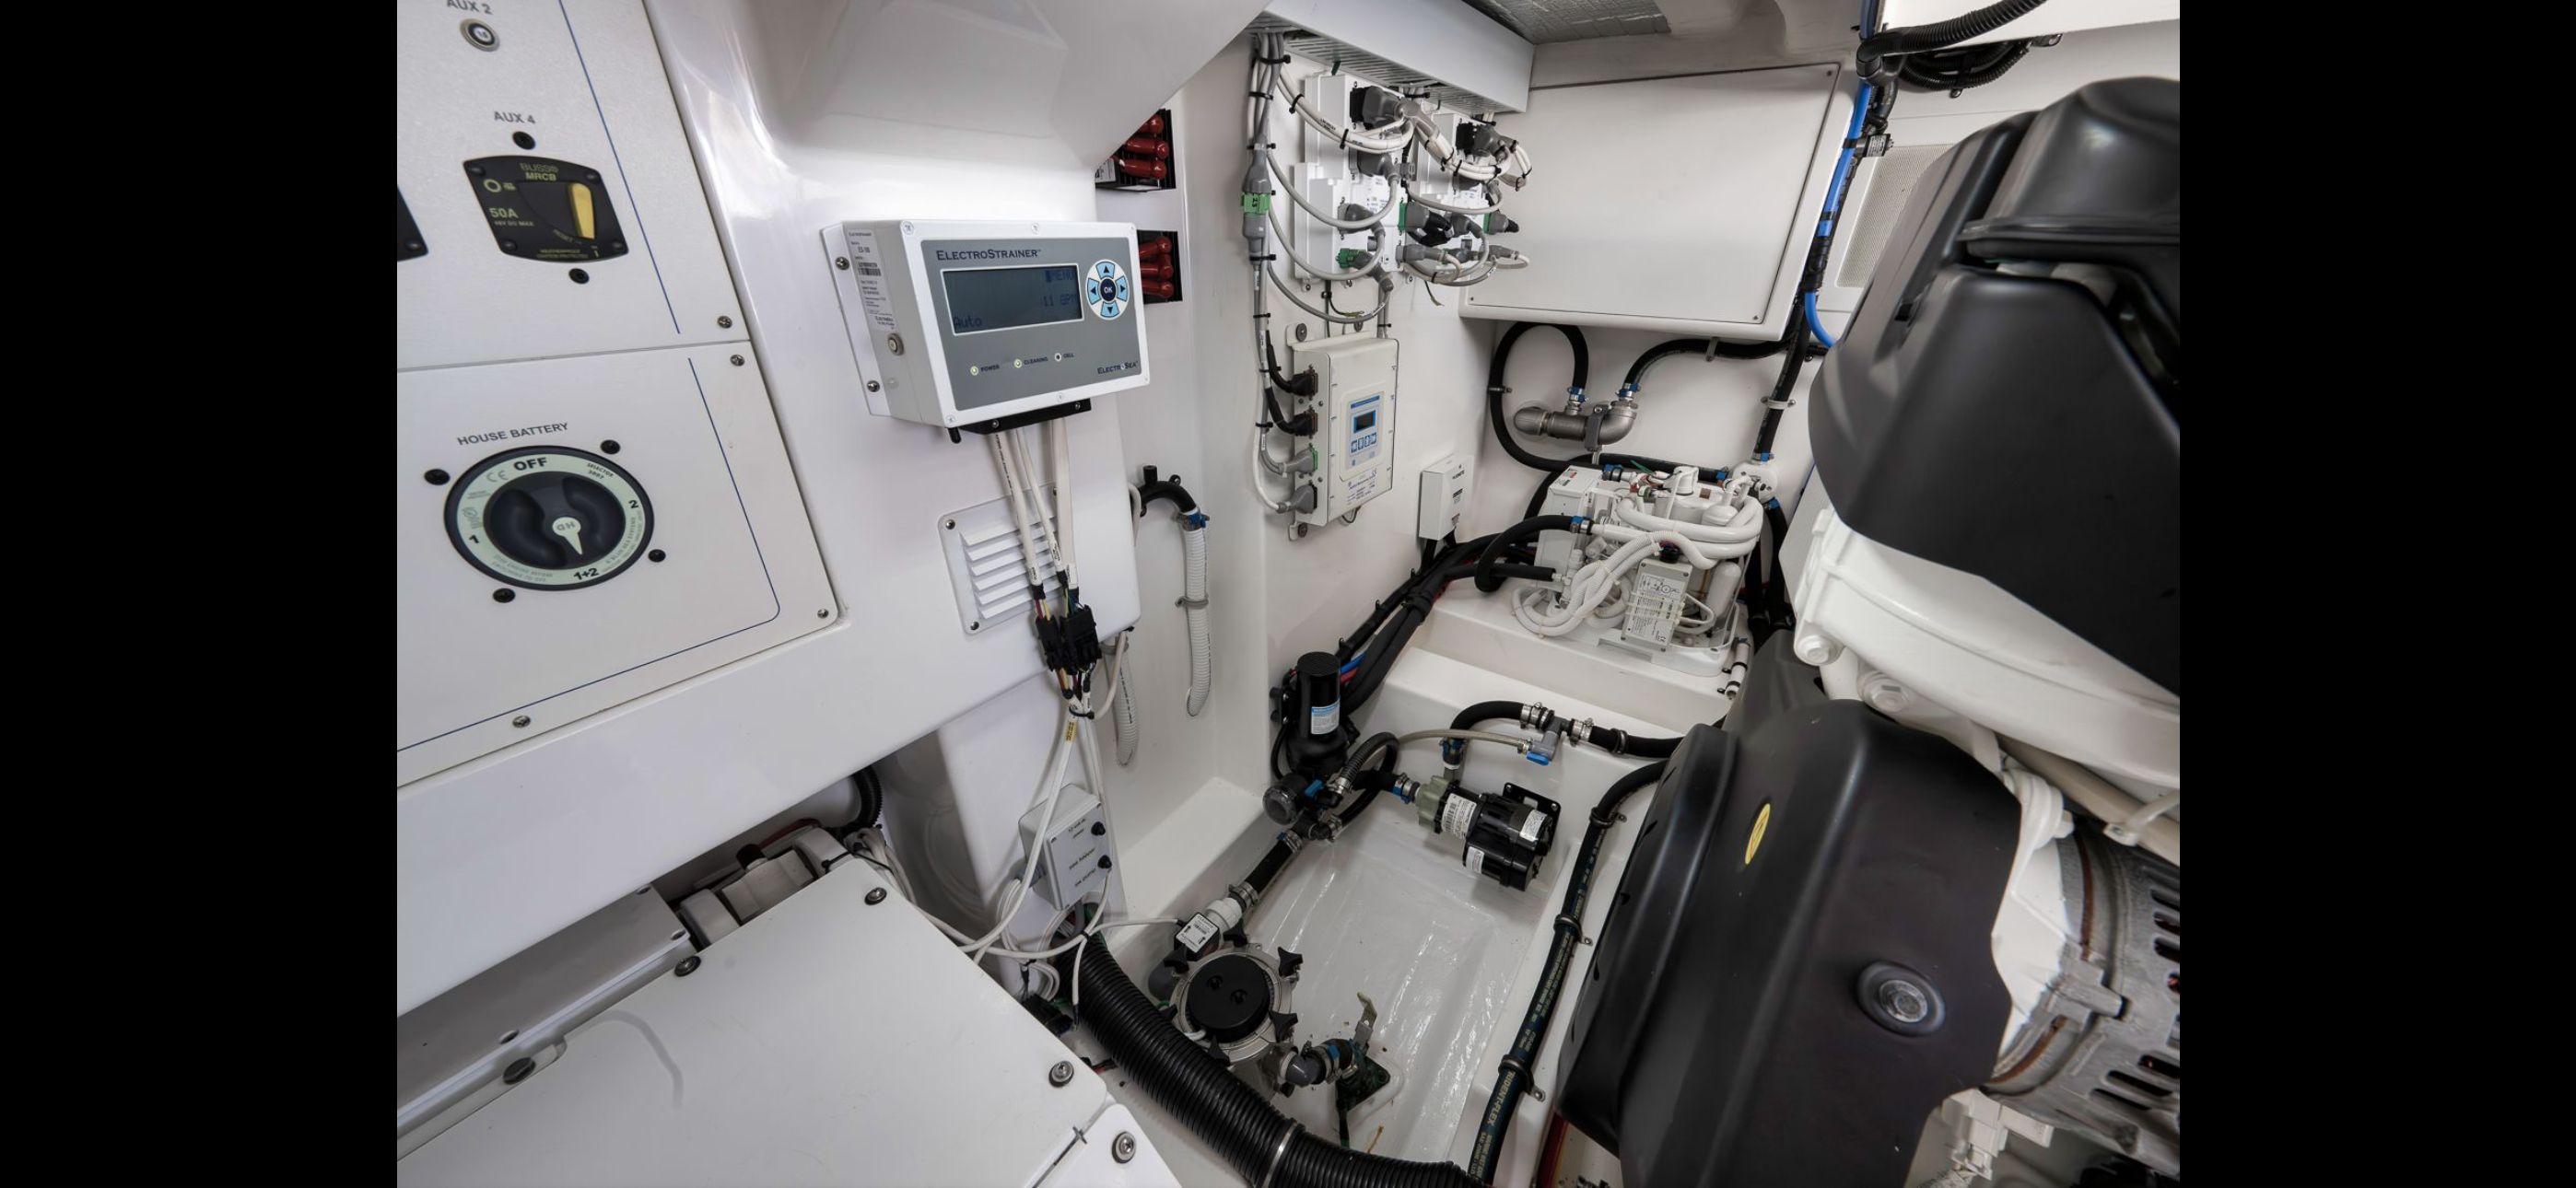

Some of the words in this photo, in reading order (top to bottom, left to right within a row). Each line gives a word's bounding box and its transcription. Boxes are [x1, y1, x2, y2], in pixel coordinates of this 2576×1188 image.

[447, 0, 480, 12] AUX
[482, 4, 493, 15] 2
[494, 111, 524, 123] AUX
[527, 115, 536, 123] 4
[525, 172, 556, 181] MRCB
[488, 208, 519, 219] 50A
[1104, 285, 1113, 294] OK
[954, 316, 983, 327] Auto
[1024, 356, 1048, 366] CLEANING
[980, 364, 1001, 372] POWER
[457, 430, 507, 446] HOUSE
[509, 423, 568, 438] BATTERY
[513, 457, 547, 472] OFF
[628, 500, 638, 508] 2
[469, 535, 479, 544] 1
[573, 567, 600, 581] 1+2
